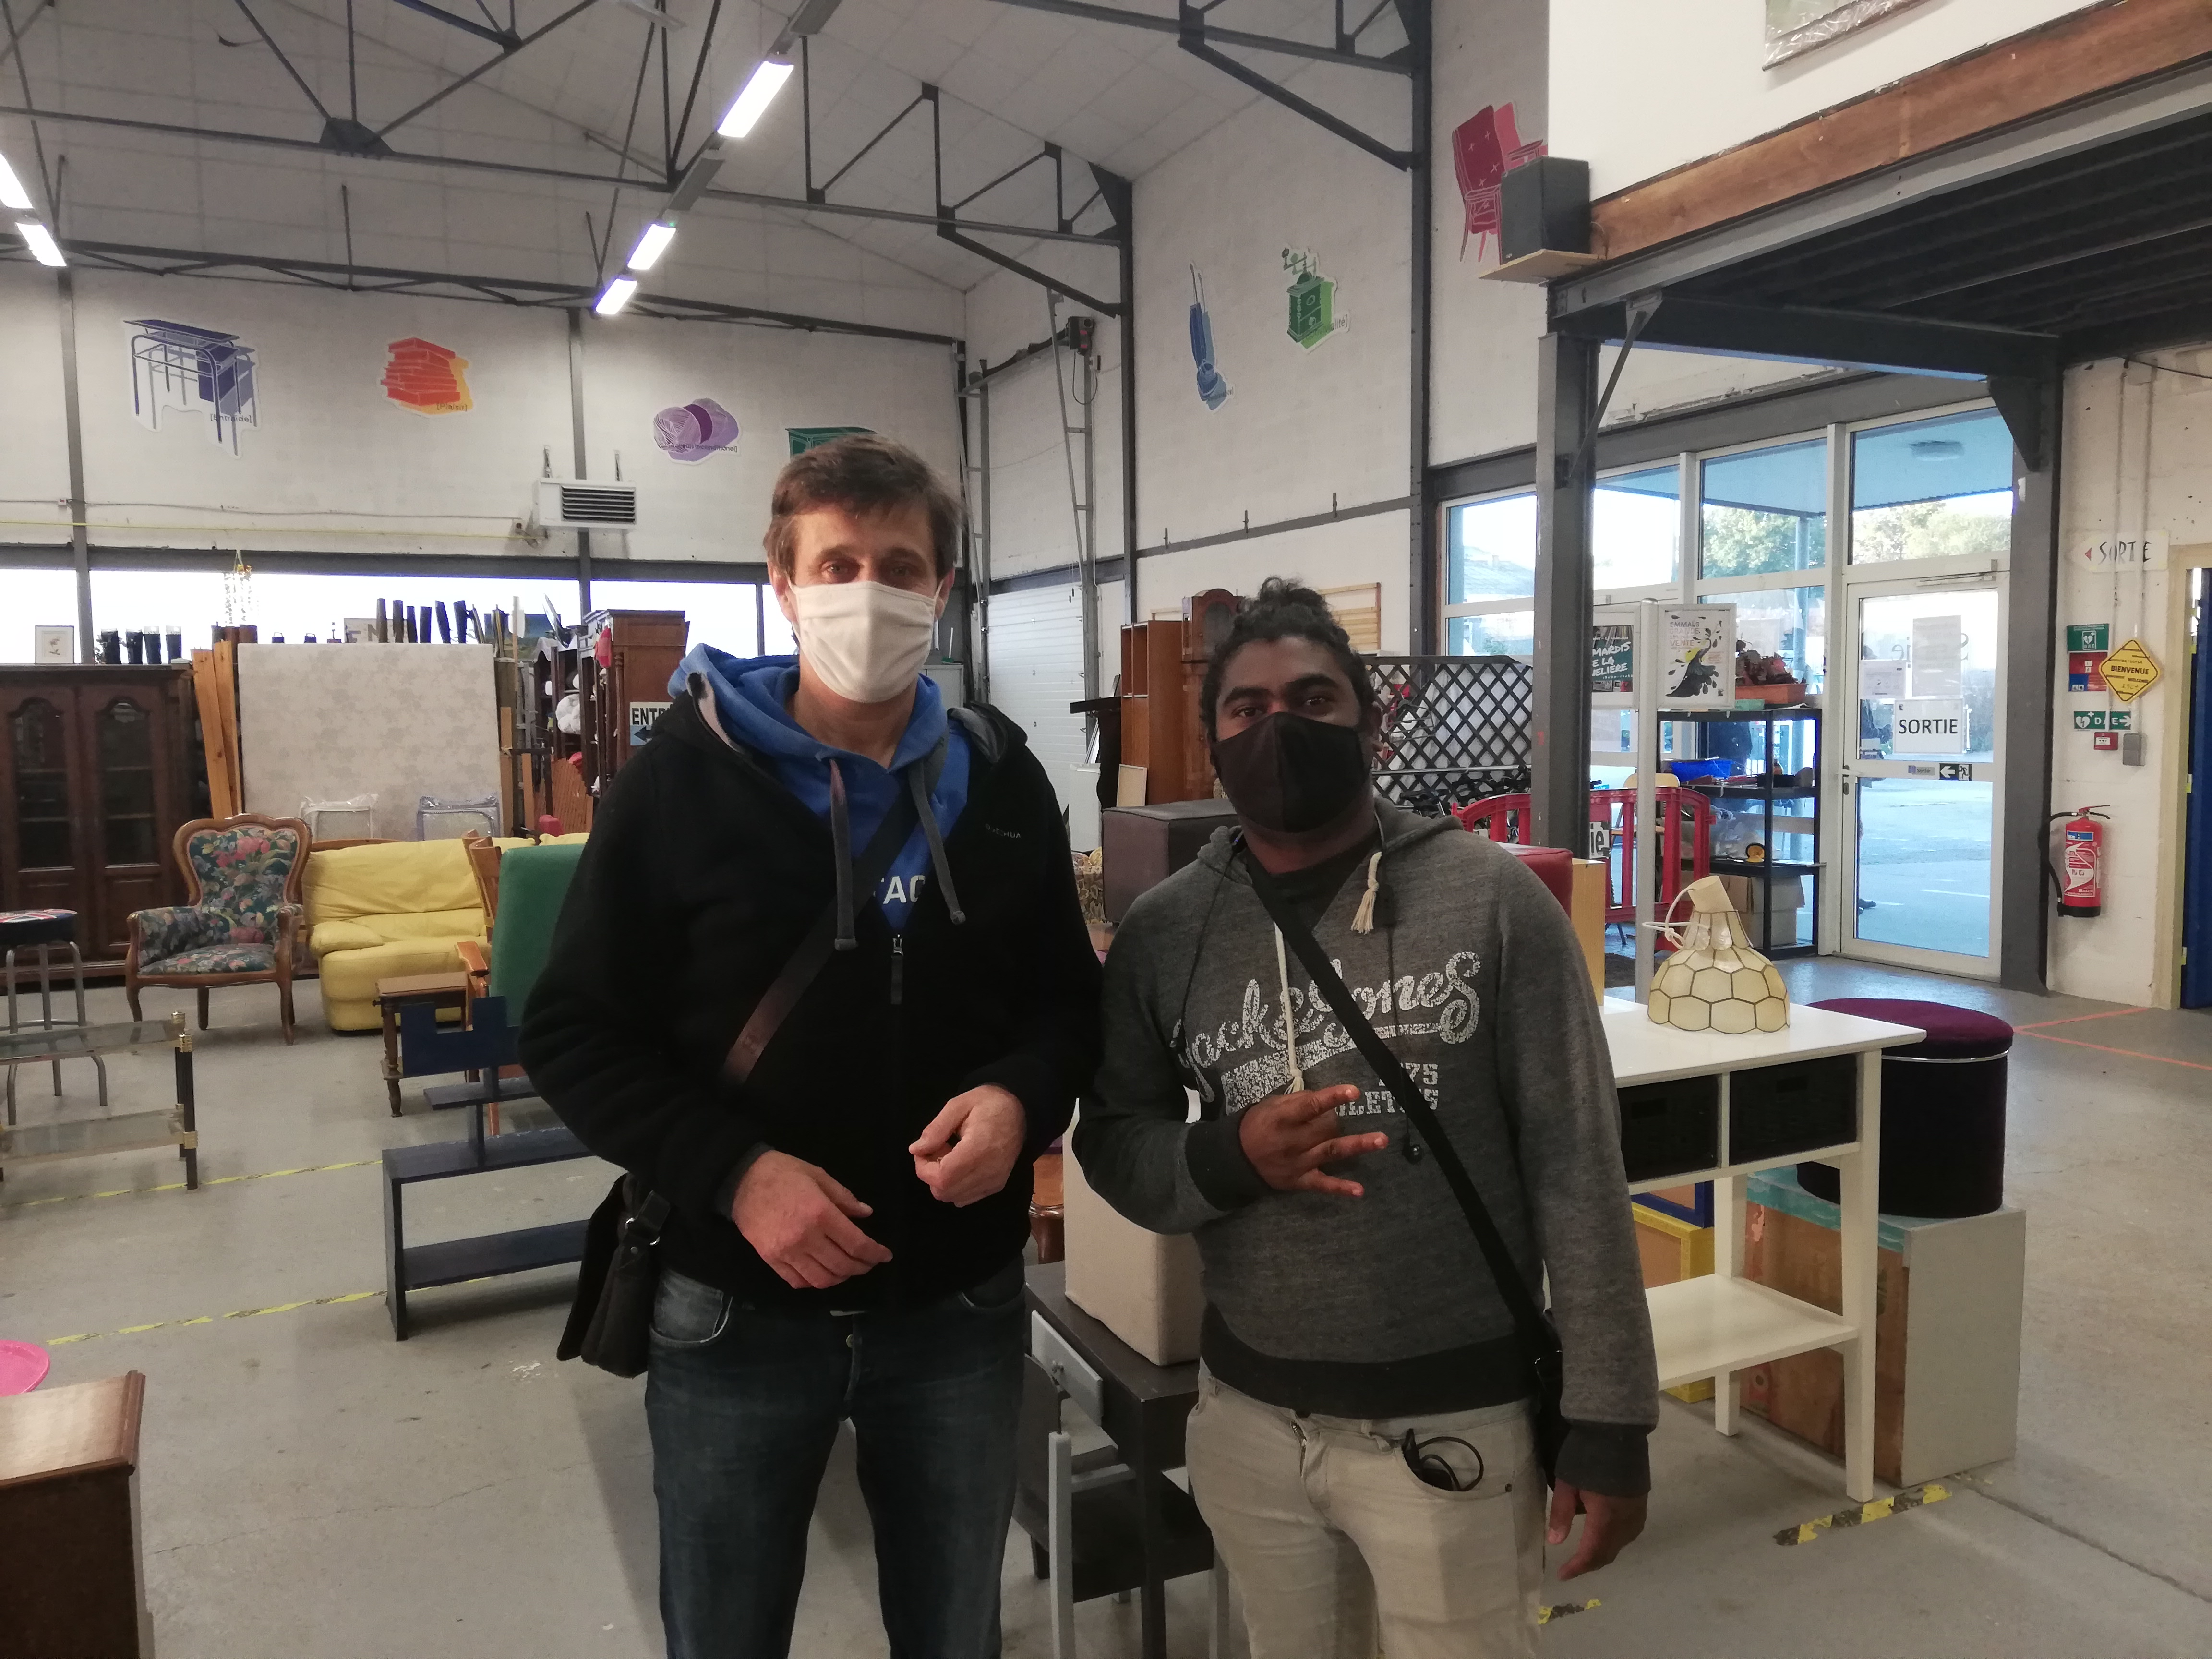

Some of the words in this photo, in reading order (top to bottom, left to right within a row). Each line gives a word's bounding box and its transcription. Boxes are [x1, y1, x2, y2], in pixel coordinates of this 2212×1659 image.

[2098, 541, 2152, 565] SORTE
[1592, 641, 1632, 657] MARDIS
[1592, 659, 1599, 667] E
[1601, 656, 1615, 666] LA
[2111, 665, 2149, 675] BIENVENUE
[1899, 719, 1958, 734] SORTIE
